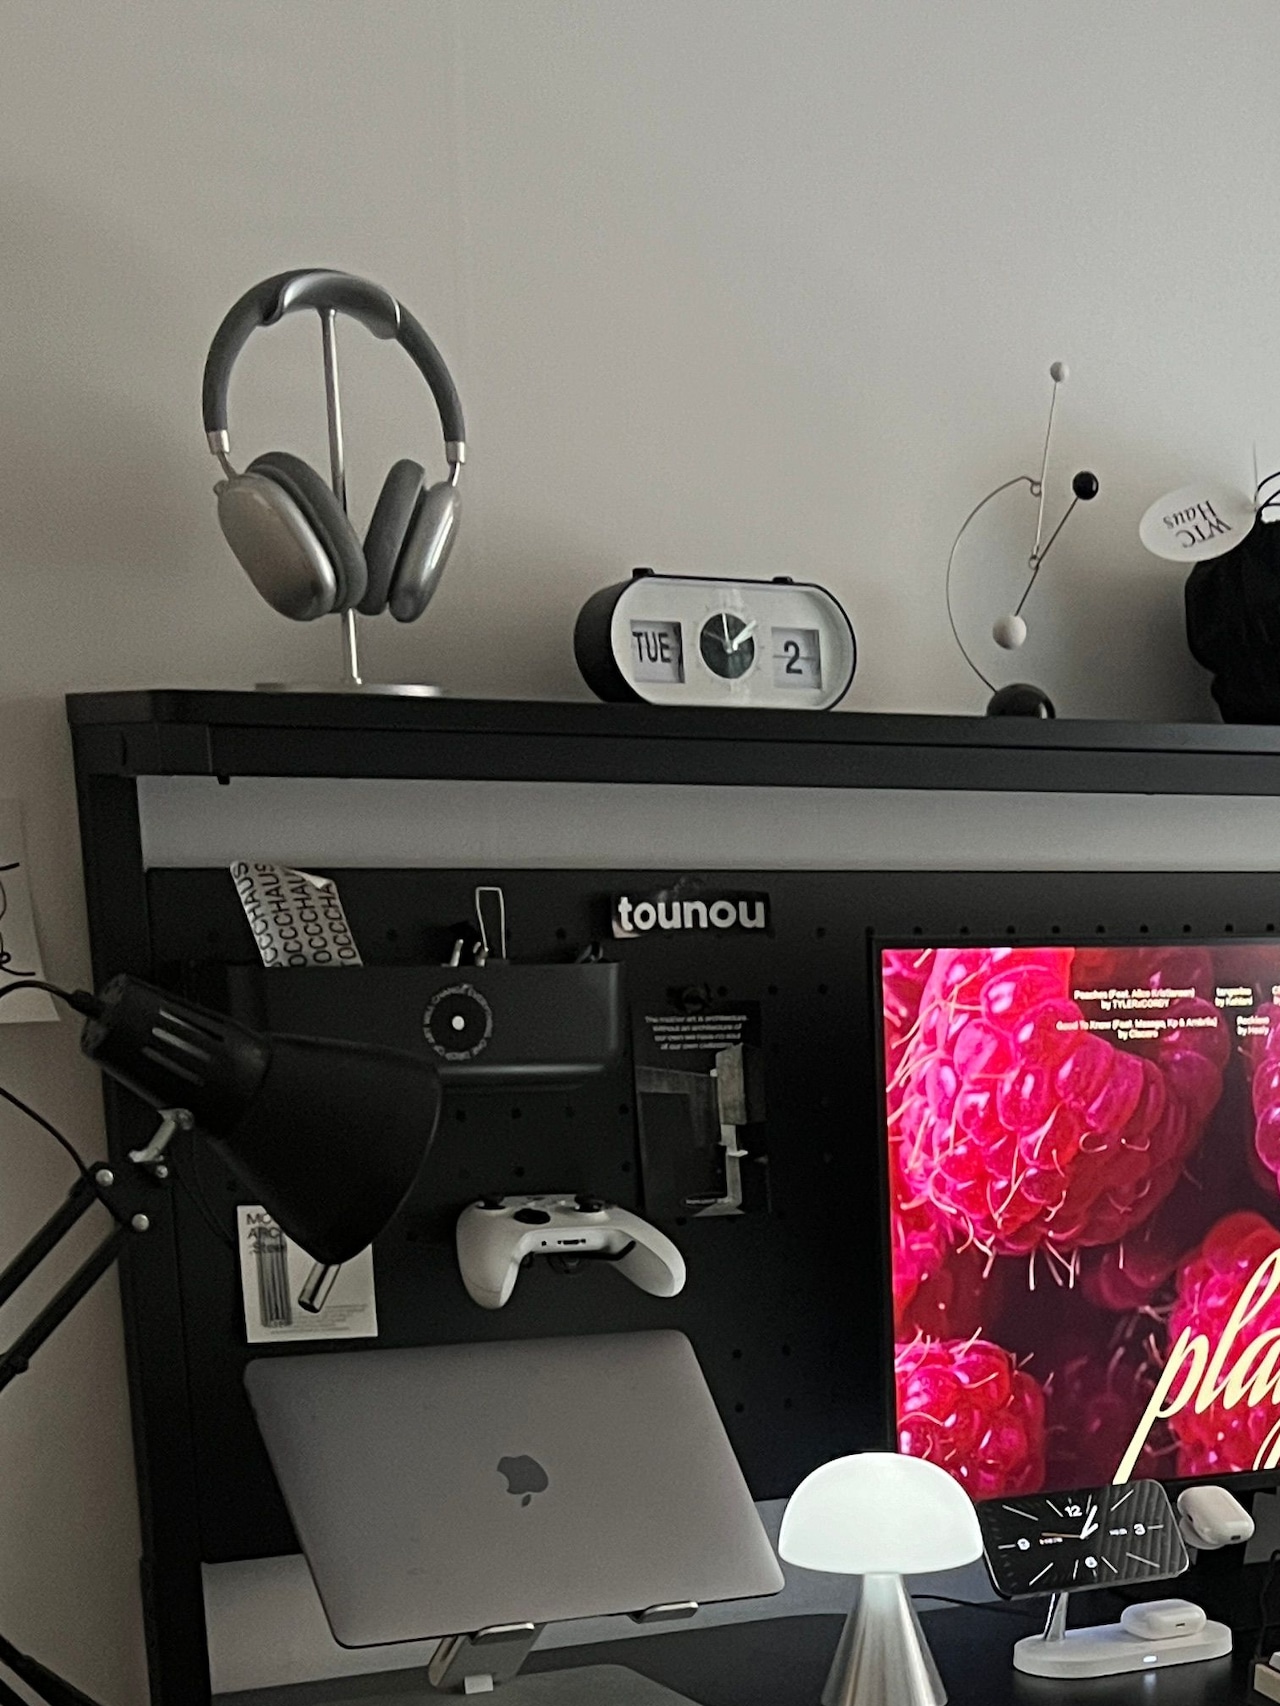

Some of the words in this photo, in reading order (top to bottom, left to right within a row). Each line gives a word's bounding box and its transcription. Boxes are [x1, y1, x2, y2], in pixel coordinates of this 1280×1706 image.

[1163, 500, 1216, 529] Haus
[632, 631, 671, 663] TUE
[784, 640, 803, 675] 2
[617, 896, 766, 931] tounou
[246, 1213, 273, 1225] MO
[248, 1226, 281, 1239] ARC
[1065, 1504, 1082, 1517] 12
[1134, 1522, 1146, 1536] 3
